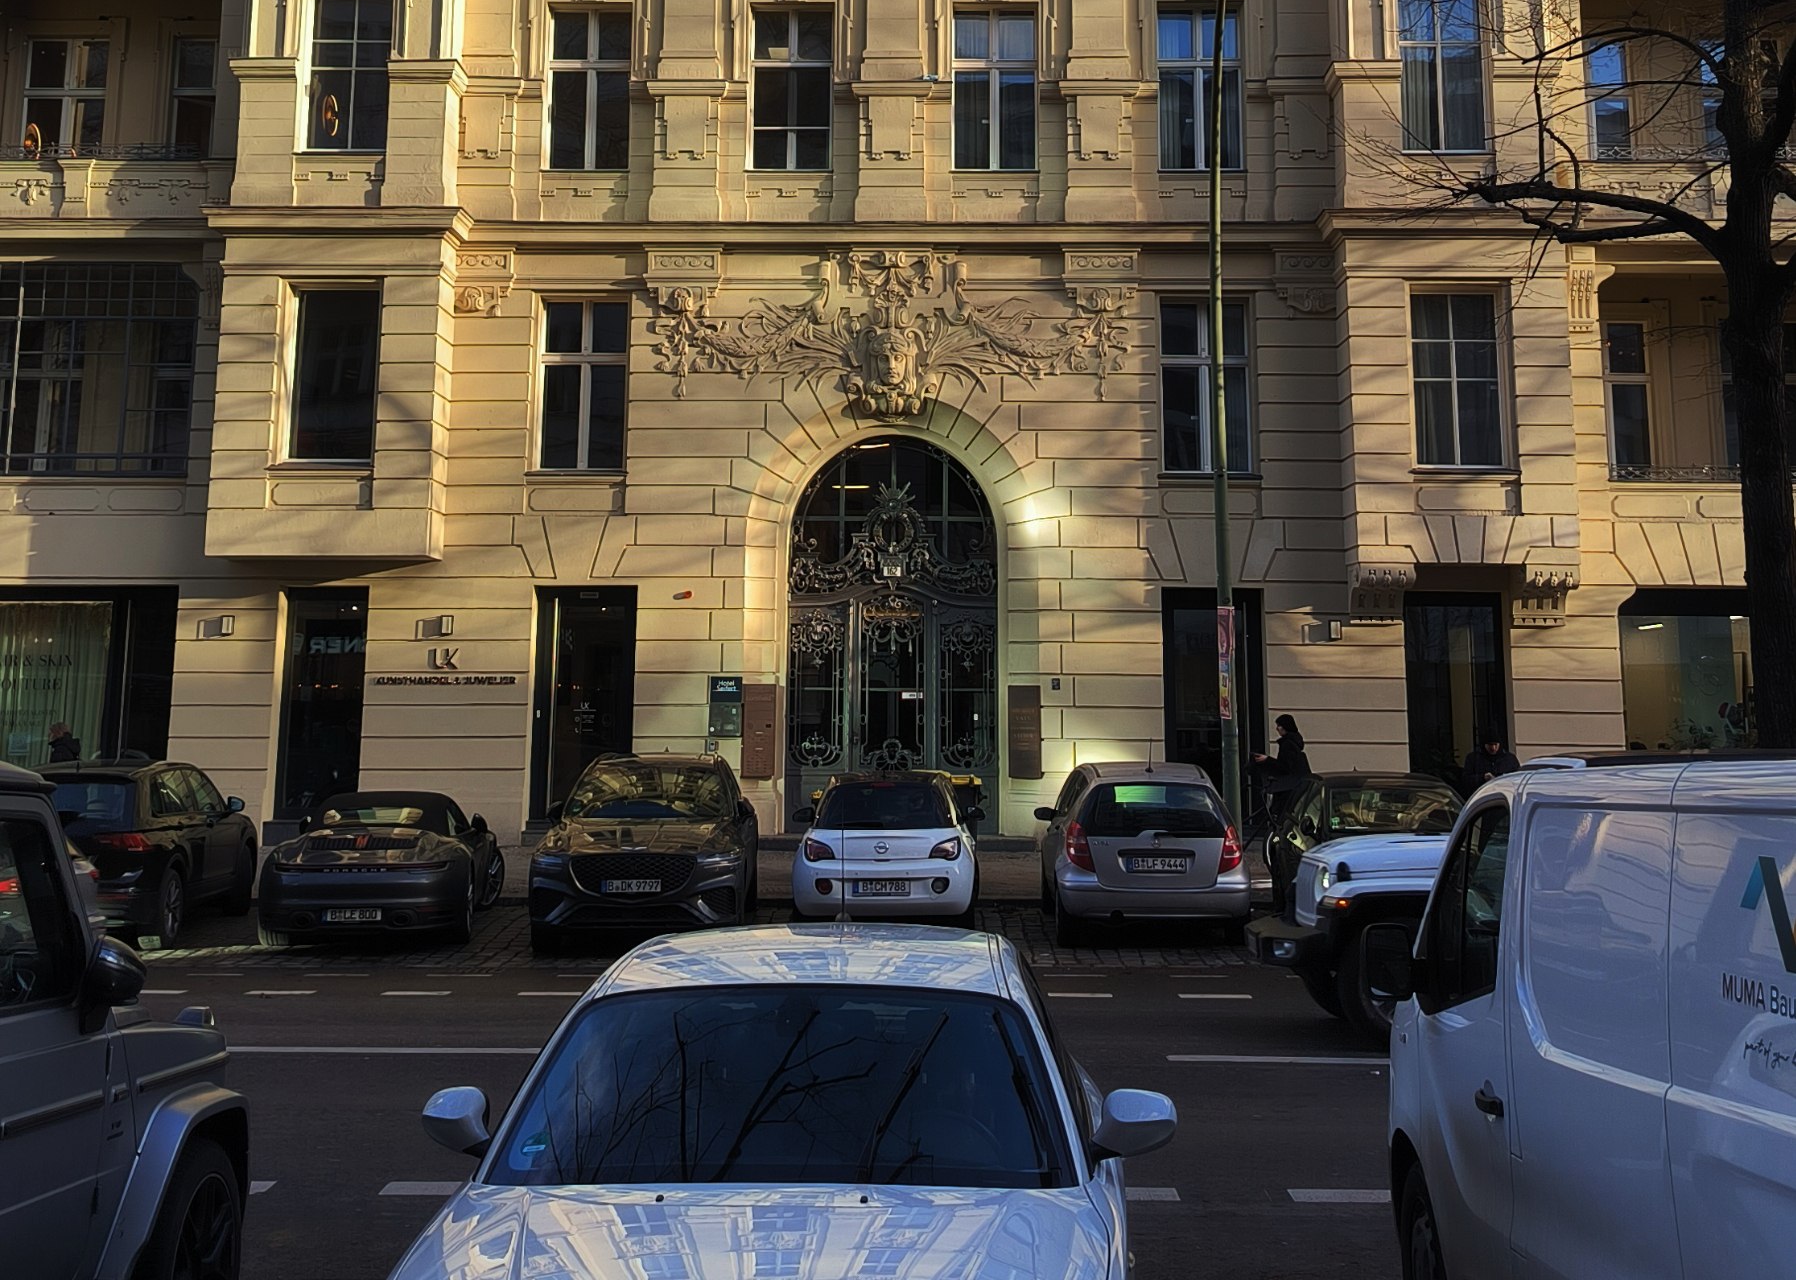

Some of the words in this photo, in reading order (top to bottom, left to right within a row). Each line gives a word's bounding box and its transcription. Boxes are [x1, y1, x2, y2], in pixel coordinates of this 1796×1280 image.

[23, 655, 32, 666] &
[427, 648, 459, 670] UK
[374, 676, 452, 686] KUNSTHANDEL
[463, 676, 516, 686] JUWELIER
[1133, 859, 1140, 868] B
[1146, 860, 1158, 869] LF
[1160, 860, 1185, 869] 9444
[608, 881, 614, 891] B
[621, 881, 633, 891] DK
[636, 881, 660, 891] 9797
[862, 882, 868, 891] B
[889, 882, 906, 891] 788
[330, 910, 337, 920] B
[1722, 972, 1766, 1010] MUMA
